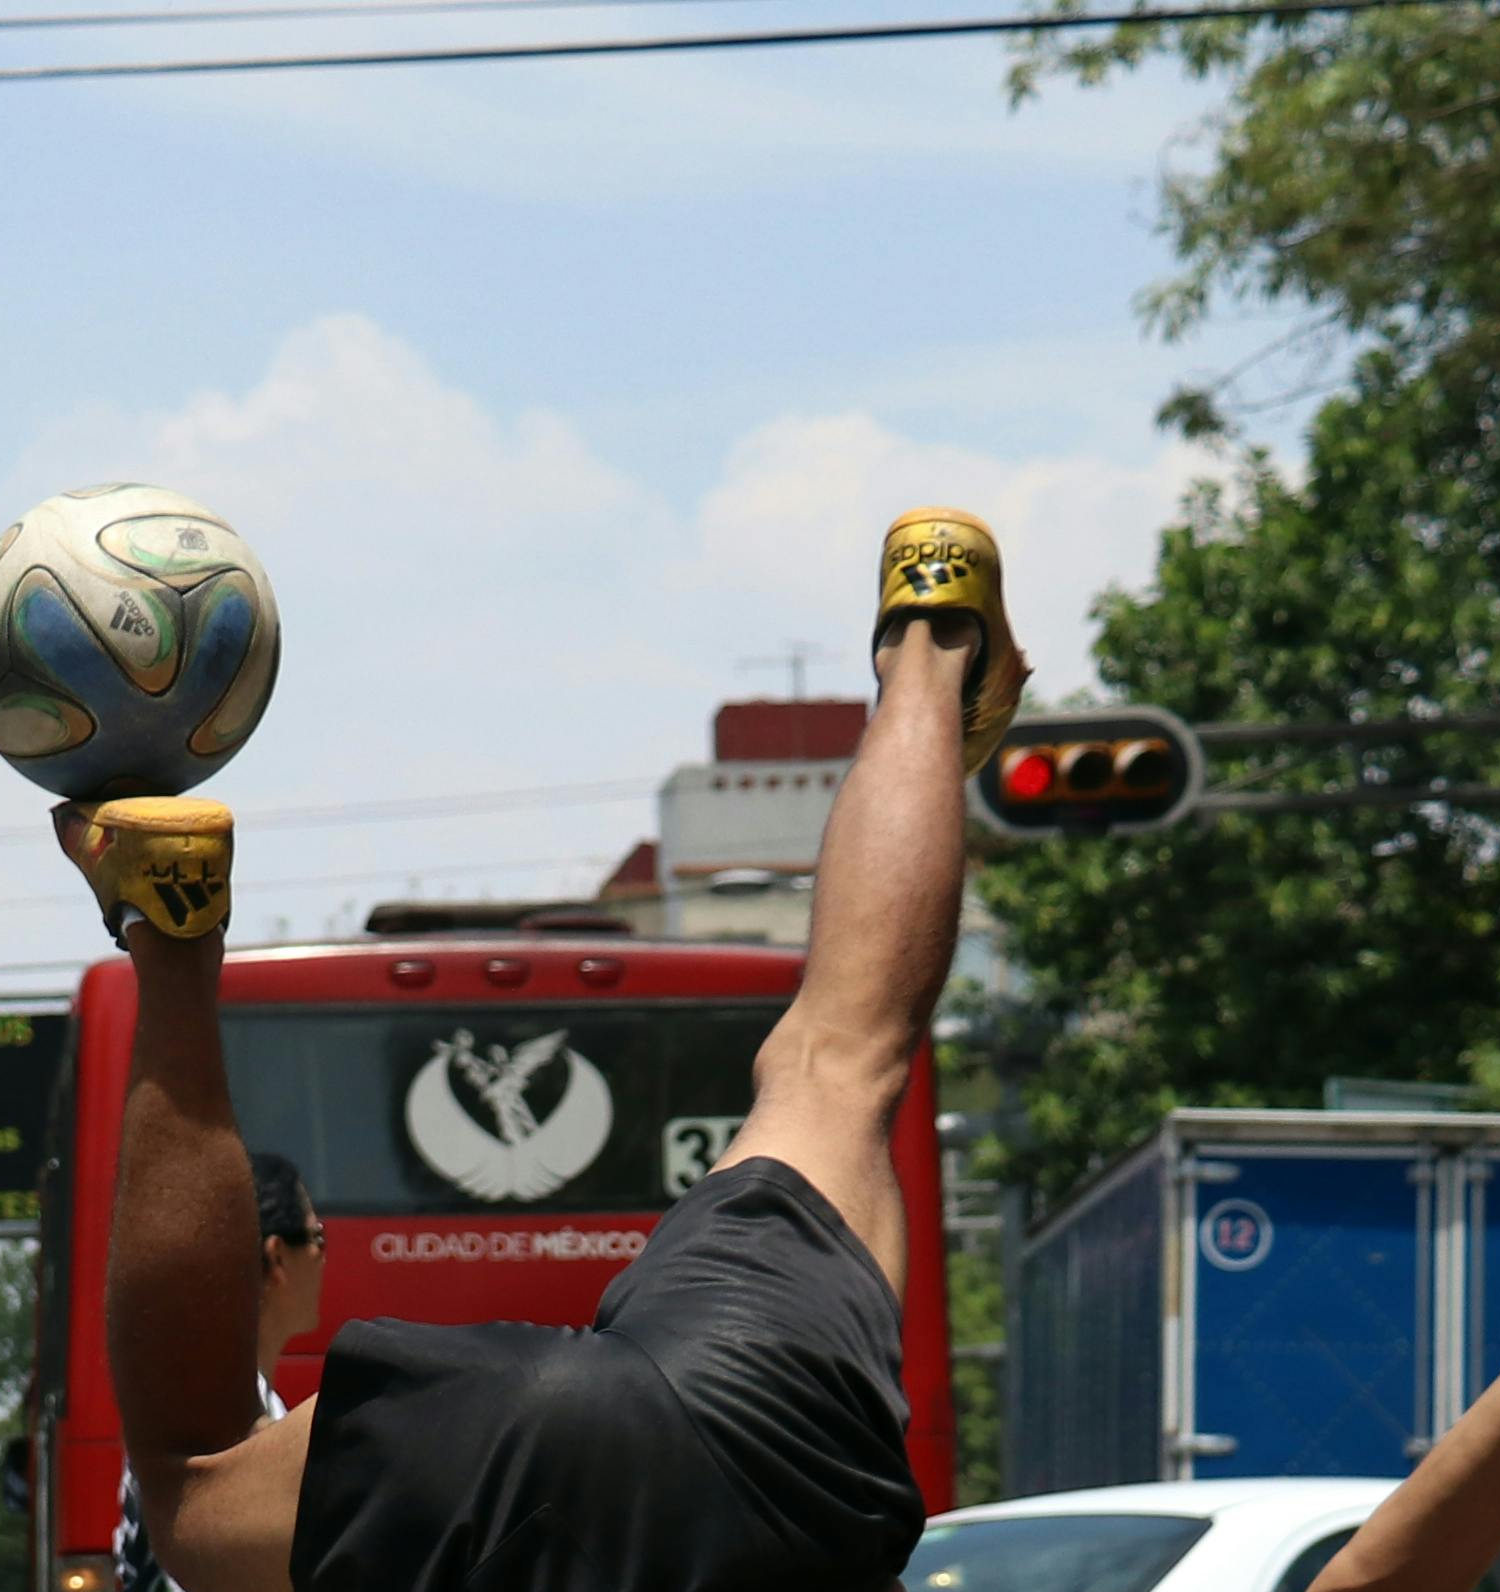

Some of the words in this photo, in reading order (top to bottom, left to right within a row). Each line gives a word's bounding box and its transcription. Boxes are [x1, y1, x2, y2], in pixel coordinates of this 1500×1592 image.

[114, 590, 156, 637] adidas
[371, 1231, 485, 1263] CIUDAD
[488, 1231, 531, 1262] DE
[532, 1225, 649, 1261] MÉXICO
[1218, 1217, 1257, 1251] 12
